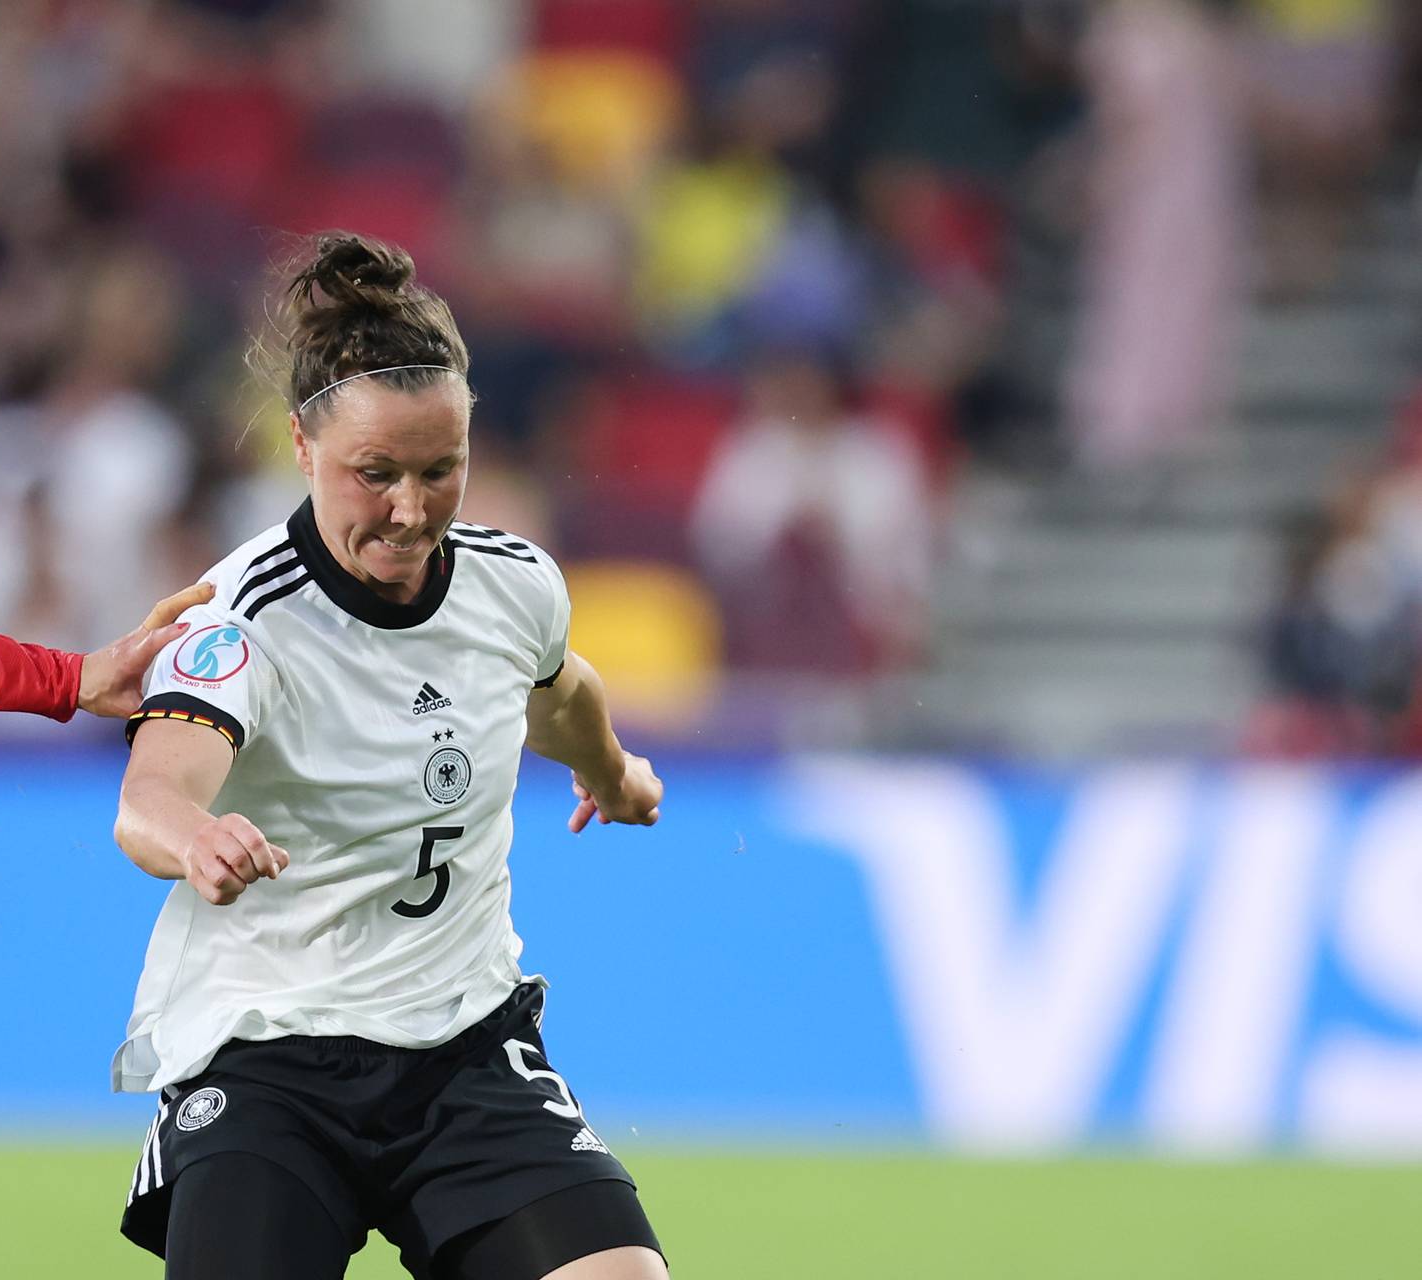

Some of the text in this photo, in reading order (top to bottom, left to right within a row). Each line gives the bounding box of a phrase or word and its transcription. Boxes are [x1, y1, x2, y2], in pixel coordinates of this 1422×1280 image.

[412, 696, 452, 715] adidas
[390, 826, 465, 918] 5
[502, 1038, 580, 1118] 5
[571, 1142, 608, 1154] adidas
